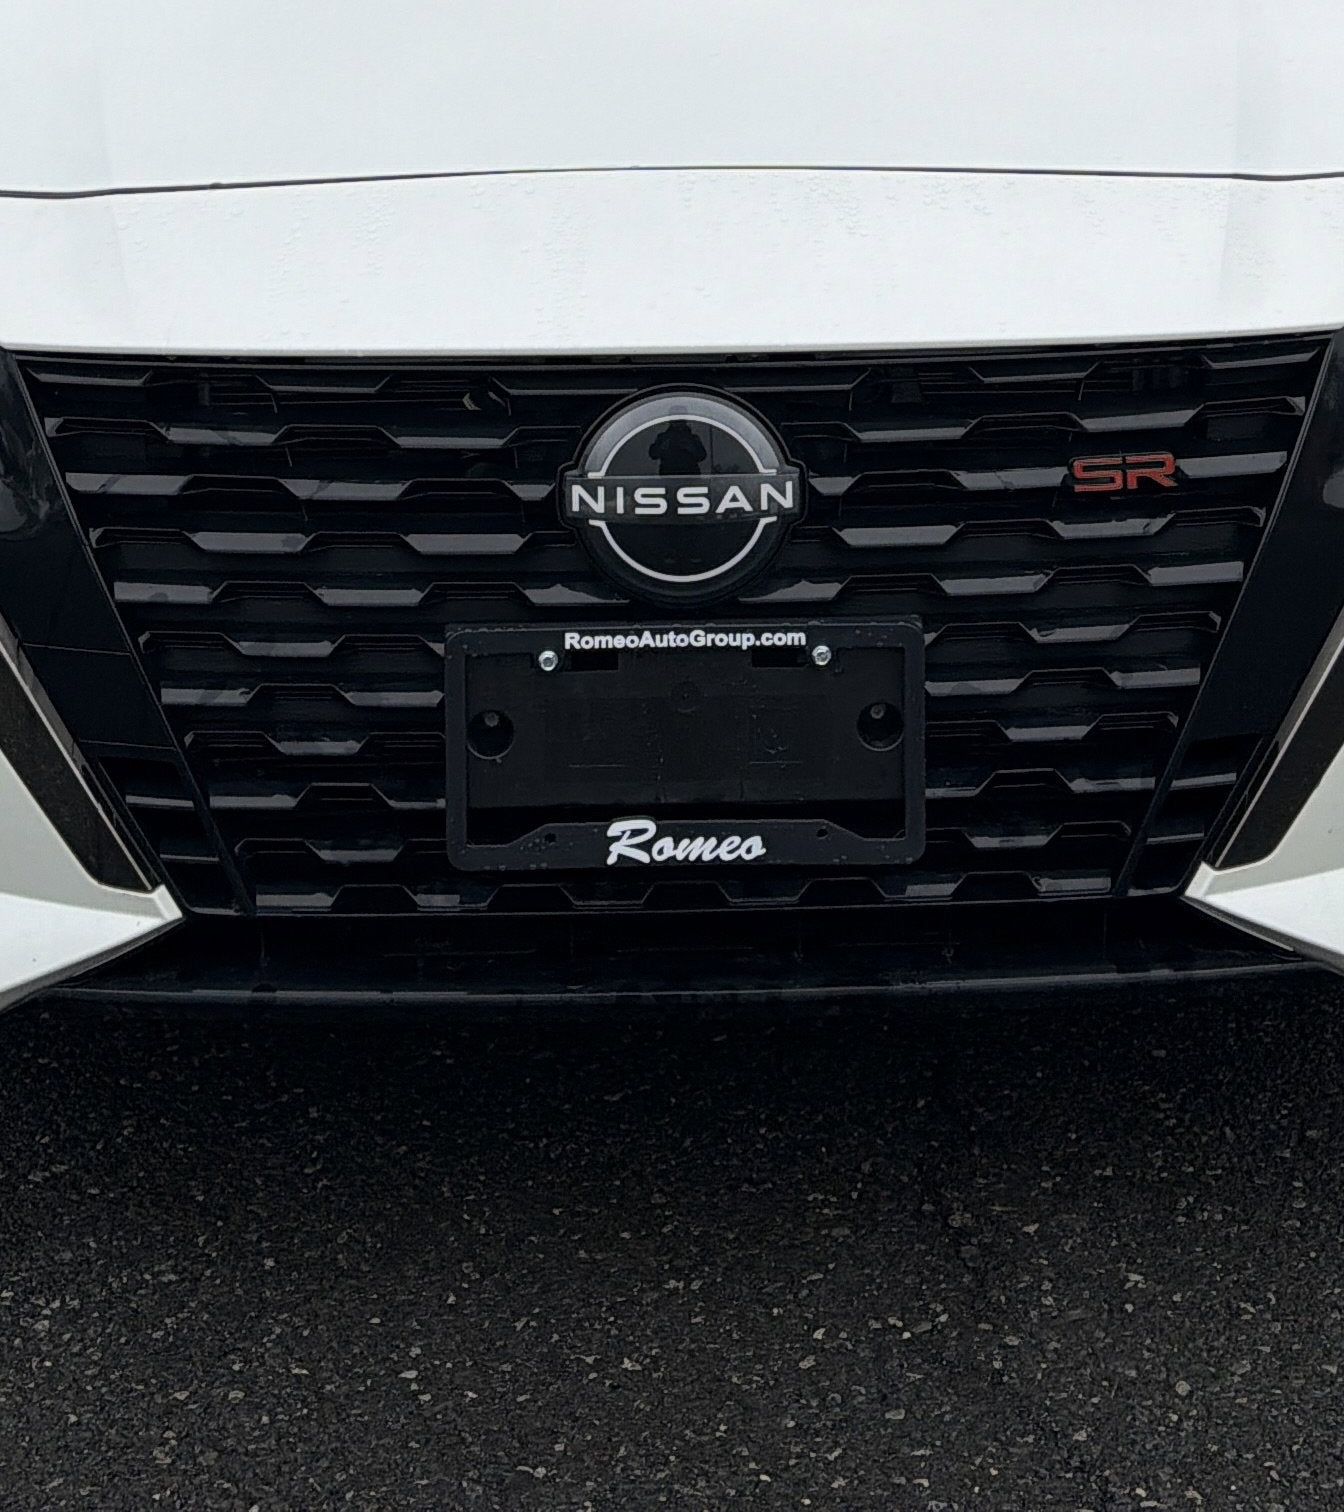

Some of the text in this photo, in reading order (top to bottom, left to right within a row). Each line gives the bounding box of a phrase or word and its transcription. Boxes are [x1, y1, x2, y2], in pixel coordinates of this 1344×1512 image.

[1073, 453, 1179, 493] SR
[571, 480, 794, 515] NISSAN
[564, 629, 807, 650] RomeoAutoGroup.com
[606, 819, 767, 865] Romeo
